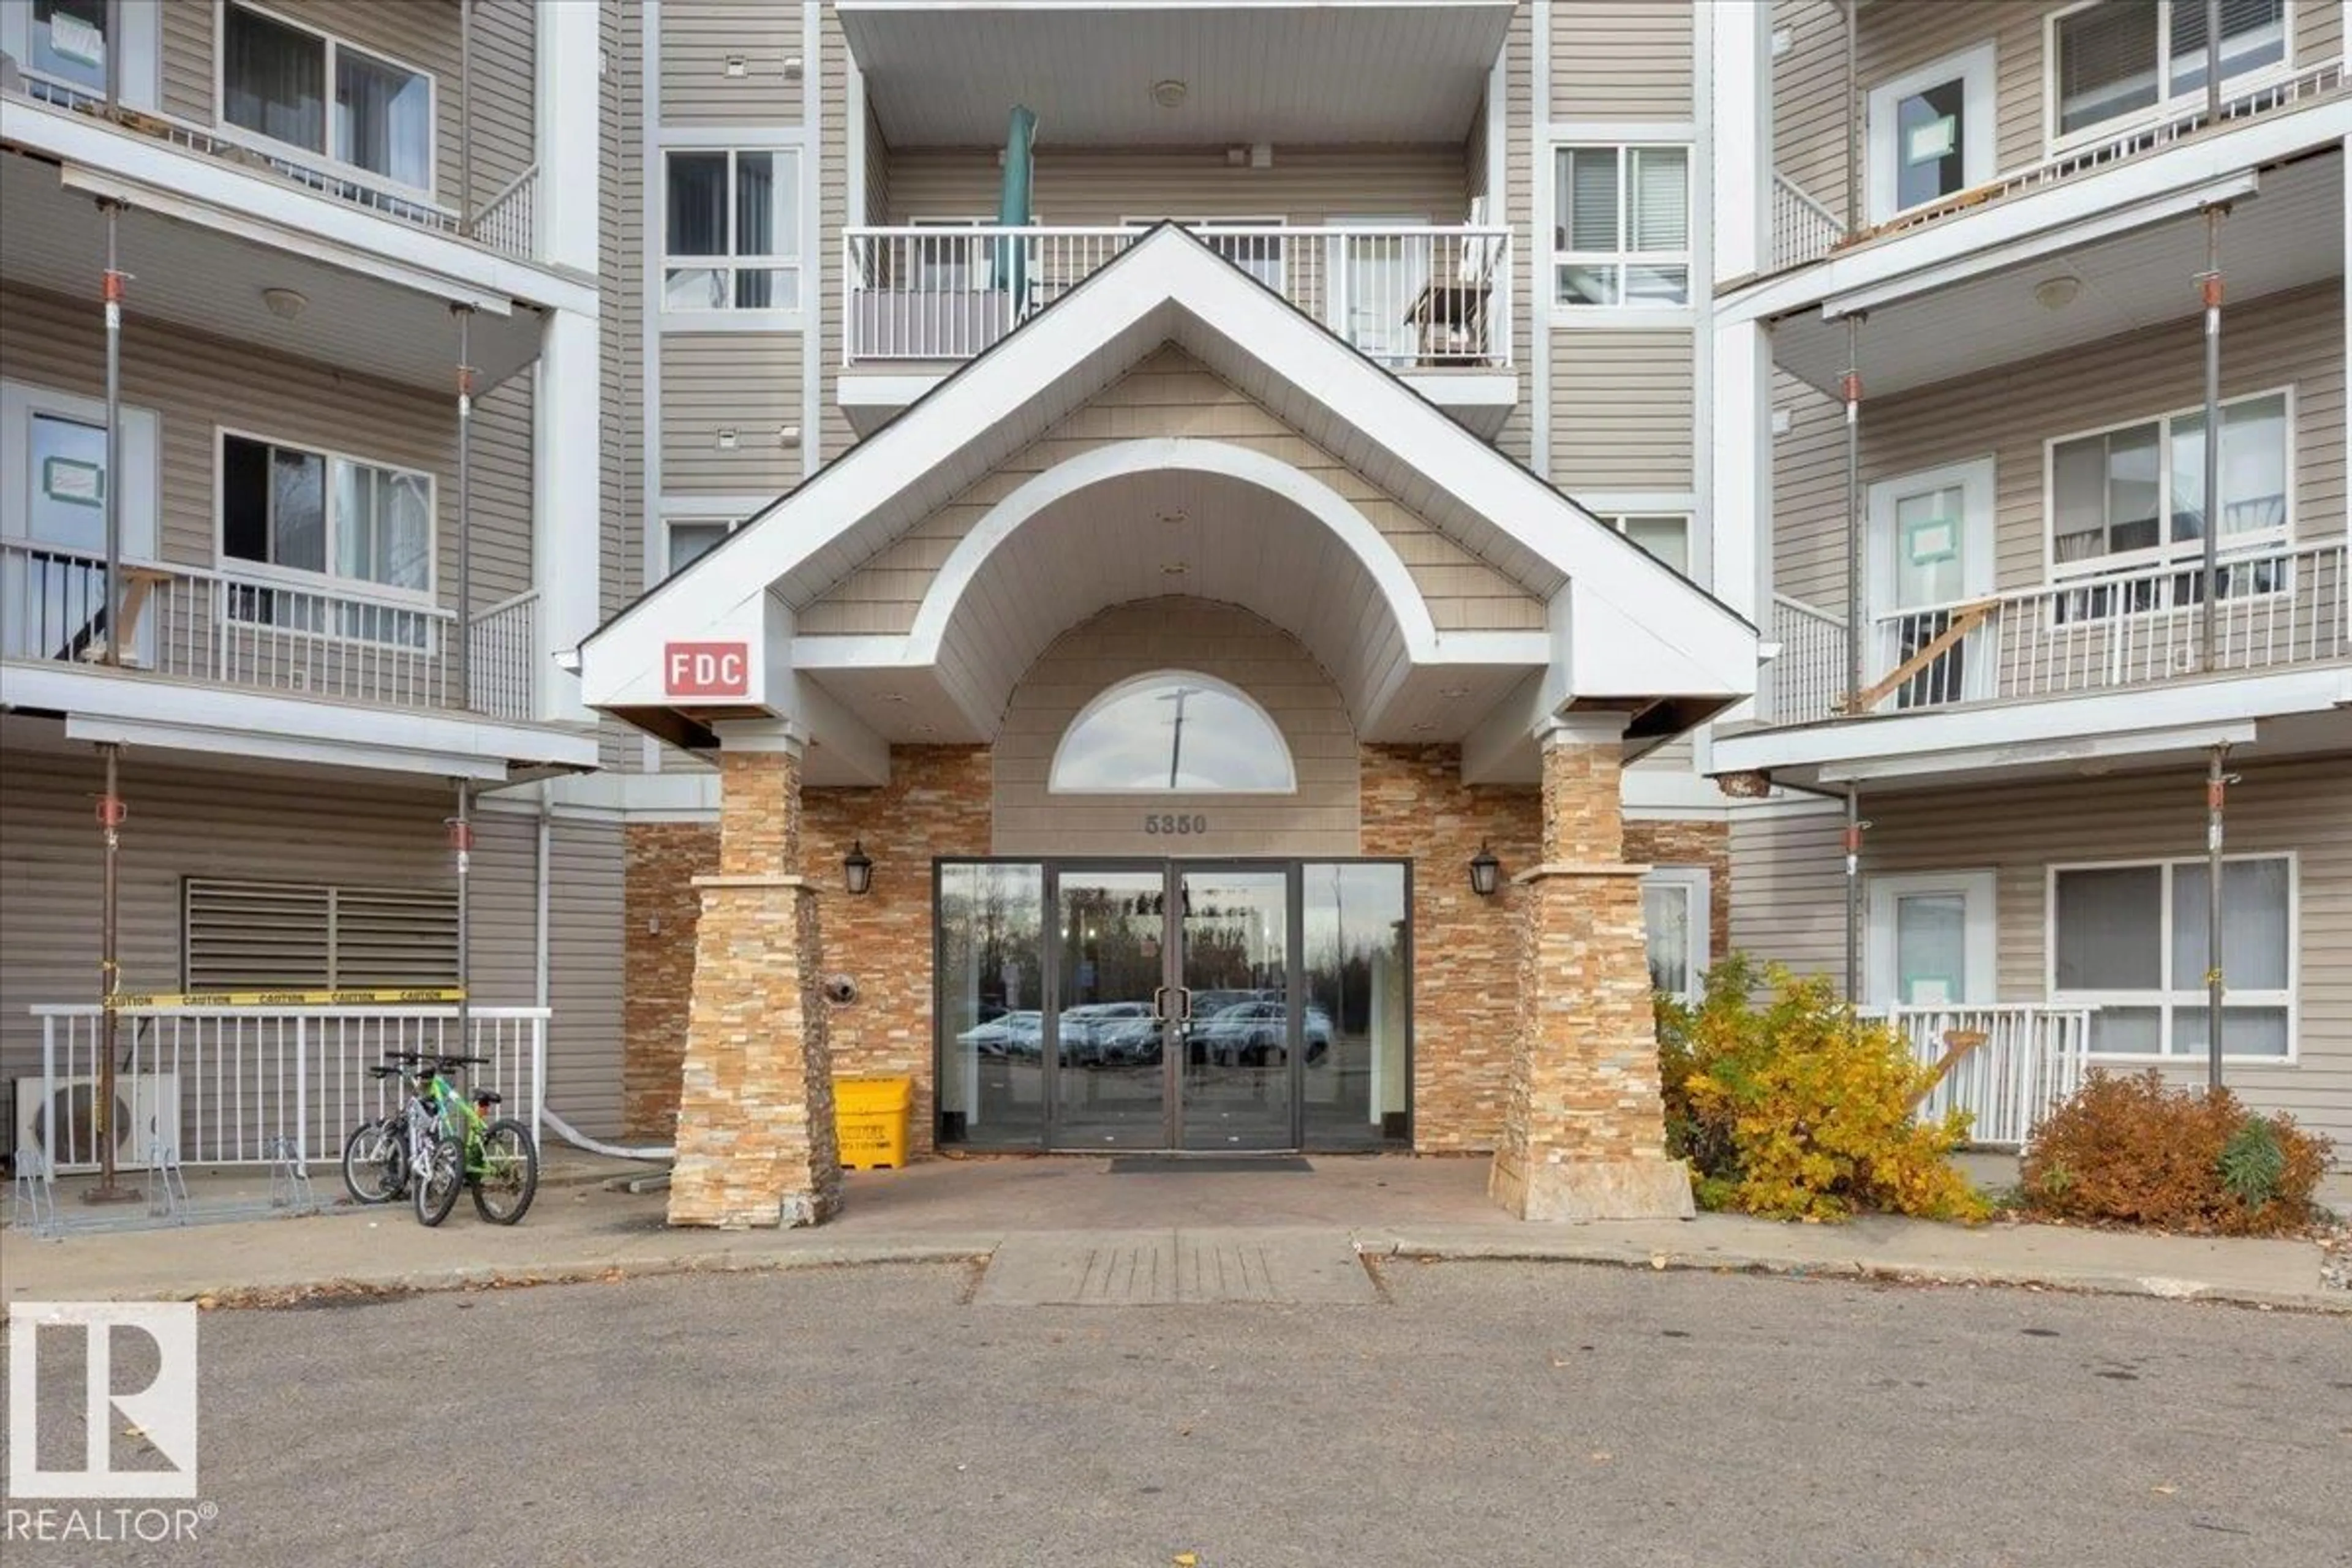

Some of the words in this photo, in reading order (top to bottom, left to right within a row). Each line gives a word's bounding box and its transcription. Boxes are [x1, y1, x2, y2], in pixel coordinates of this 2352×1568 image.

[672, 653, 741, 685] FDC
[1145, 814, 1207, 834] 5350
[104, 994, 152, 1006] CAUTION
[182, 993, 230, 1006] CAUTION
[258, 992, 305, 1004] CAUTION
[331, 992, 375, 1003] CAUTION
[399, 990, 442, 1001] CAUTION
